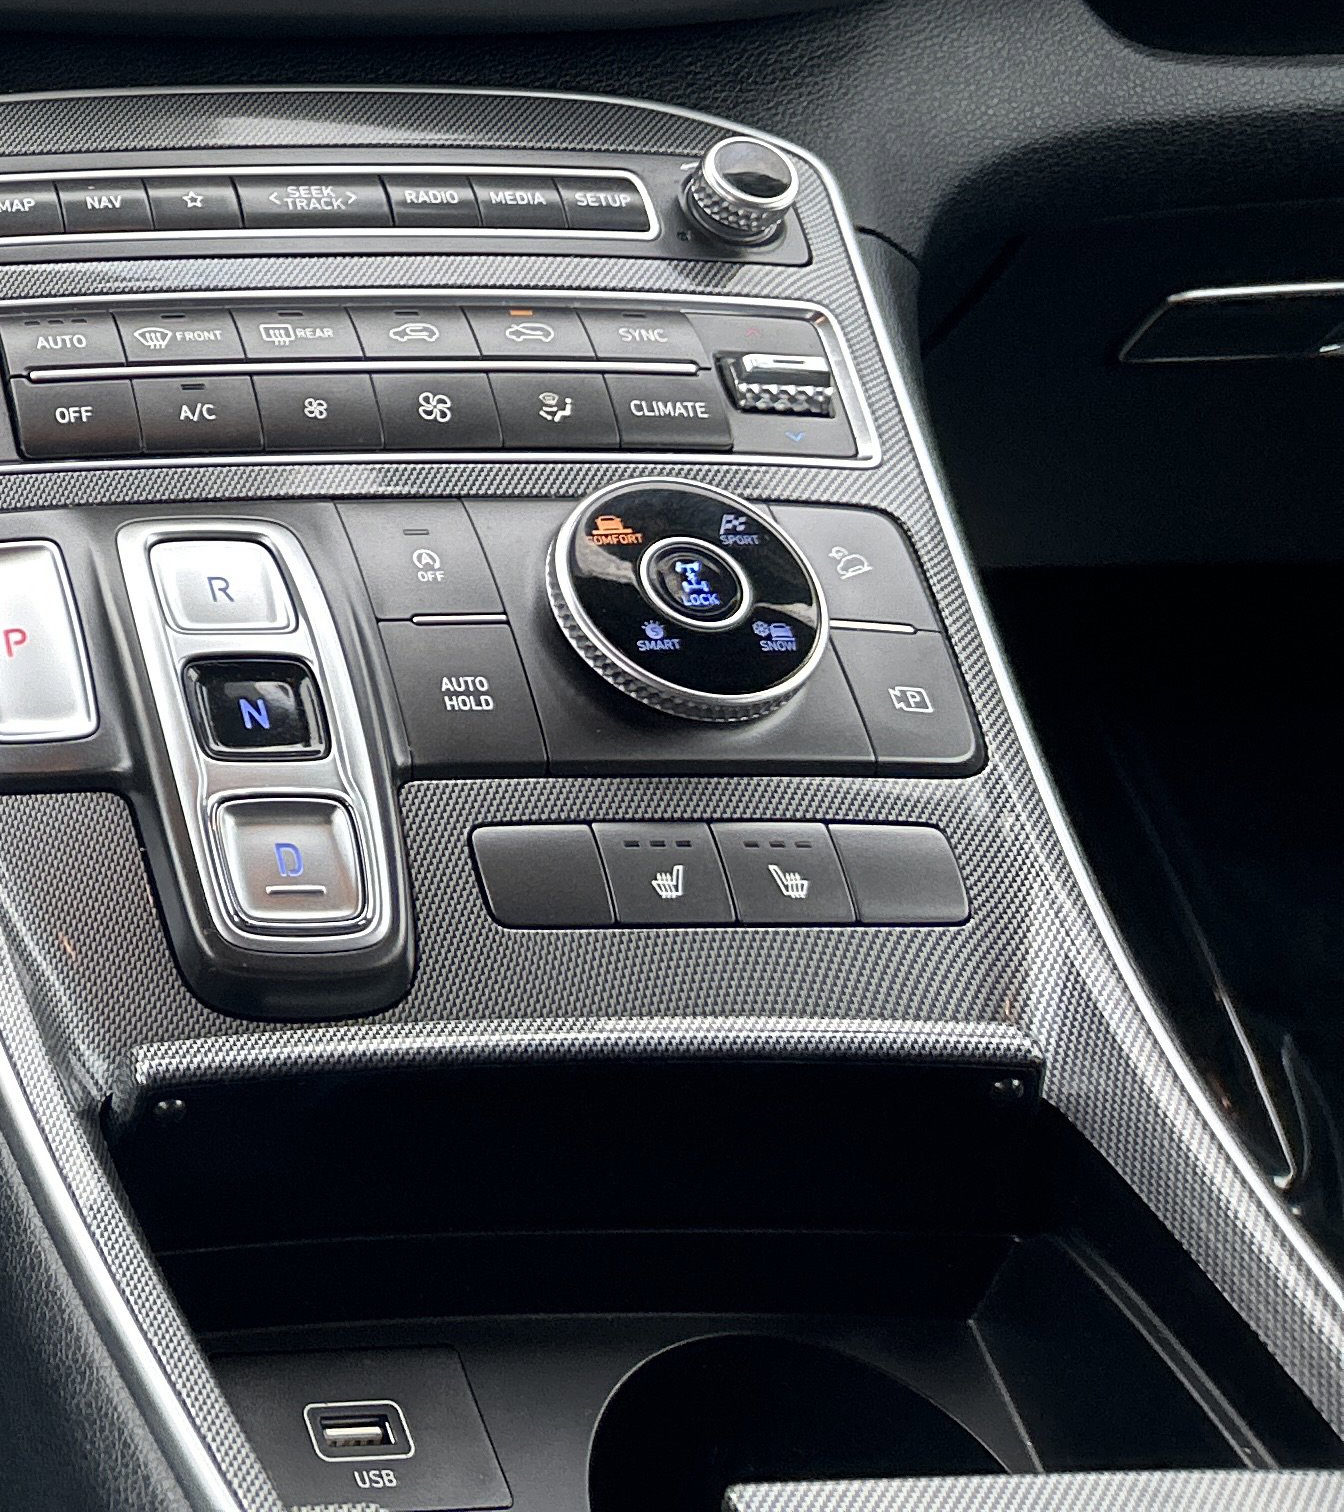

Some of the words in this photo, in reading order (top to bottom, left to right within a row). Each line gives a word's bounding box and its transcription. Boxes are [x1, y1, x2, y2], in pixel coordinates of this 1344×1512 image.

[287, 186, 335, 198] SEEK
[405, 190, 459, 205] RADIO
[489, 191, 547, 205] MEDIA
[86, 195, 122, 209] NAV
[284, 197, 346, 210] TRACK
[575, 192, 631, 208] SETUP
[176, 330, 222, 342] FRONT
[296, 327, 334, 339] REAR
[618, 327, 669, 343] SYNC
[36, 335, 87, 350] AUTO
[55, 406, 93, 423] OFF
[179, 403, 217, 421] A/C
[630, 400, 709, 419] CLIMATE
[587, 533, 643, 545] COMFORT
[720, 534, 760, 545] SPORT
[417, 570, 445, 582] OFF
[206, 576, 235, 603] R
[681, 593, 720, 607] LOCK
[3, 628, 28, 658] P
[636, 639, 681, 651] SMART
[760, 640, 797, 651] SNOW
[441, 676, 489, 692] AUTO
[444, 695, 494, 711] HOLD
[239, 698, 271, 730] N
[274, 842, 304, 877] D
[354, 1470, 397, 1488] USB
